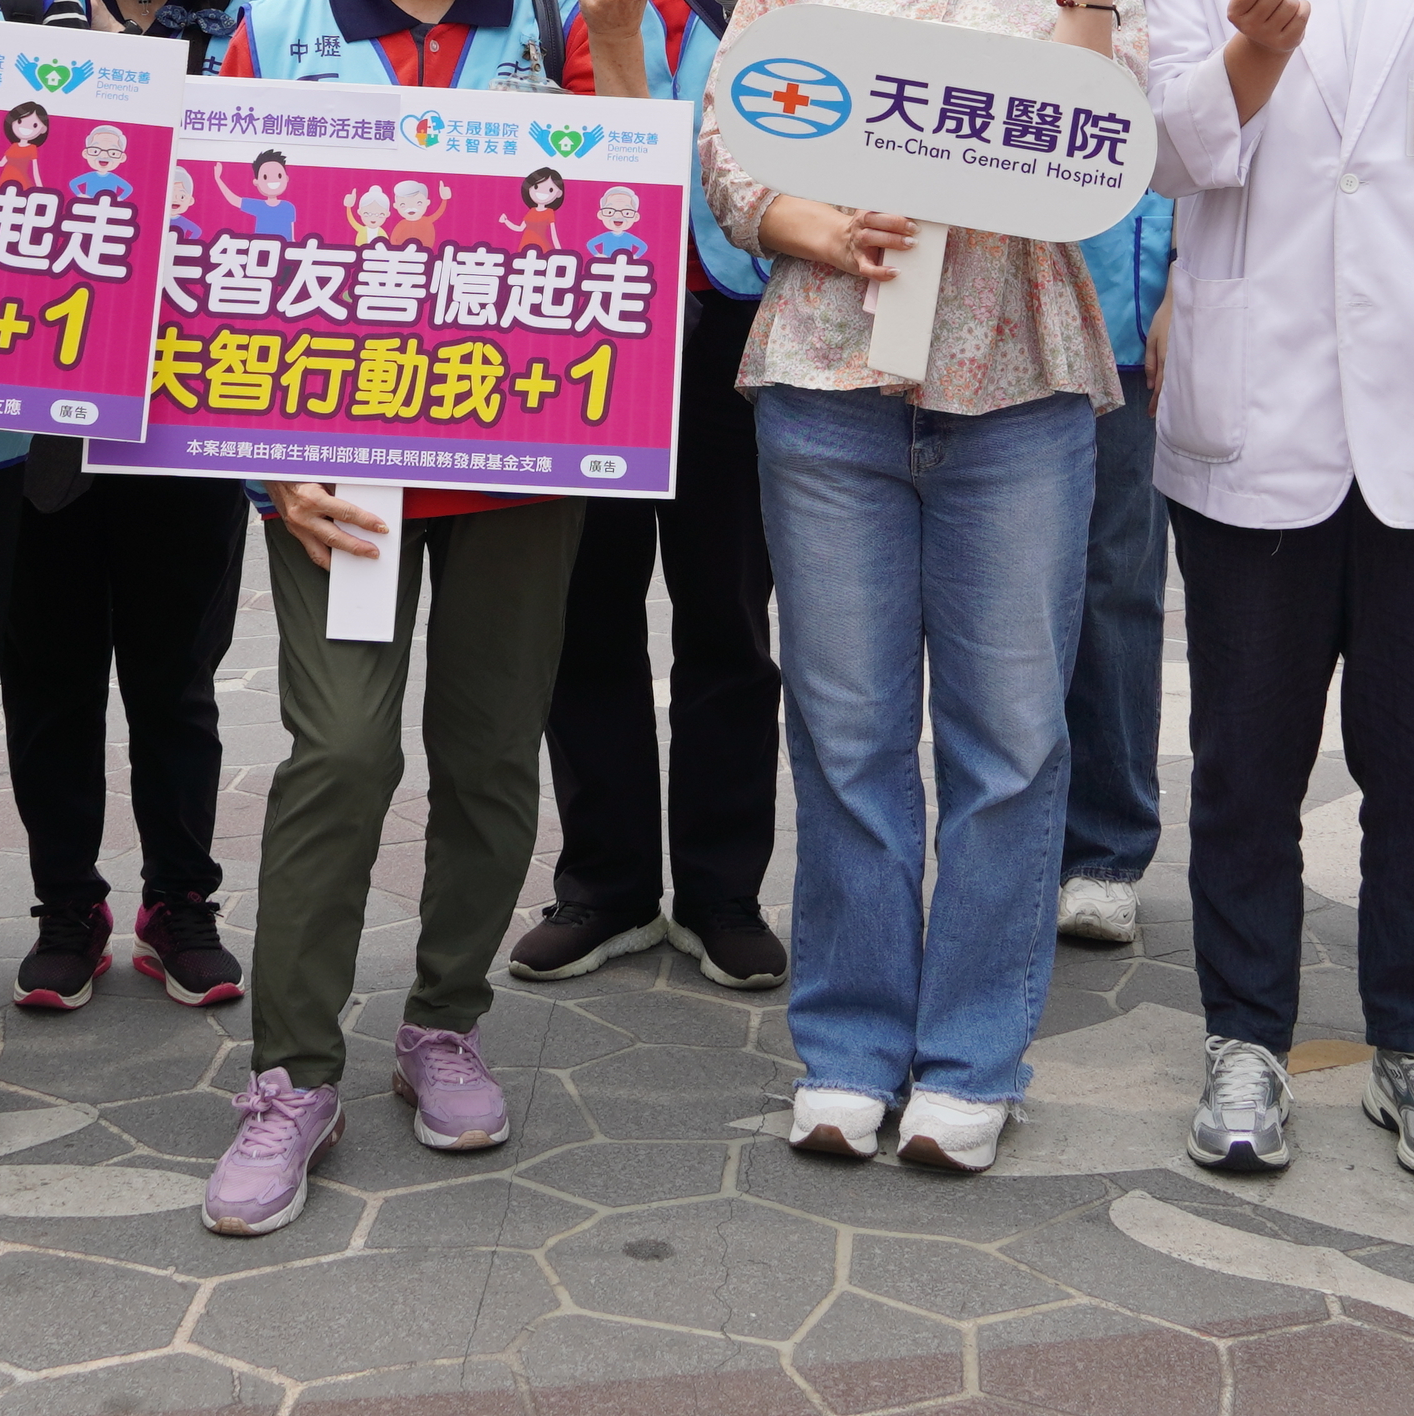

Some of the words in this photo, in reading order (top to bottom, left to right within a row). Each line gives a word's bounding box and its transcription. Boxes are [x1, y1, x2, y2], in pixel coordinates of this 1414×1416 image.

[289, 35, 342, 64] 中壢
[97, 67, 151, 85] 失智友善
[94, 89, 129, 102] Friends
[97, 80, 139, 93] Dementia
[179, 108, 229, 133] 陪伴
[262, 114, 396, 142] 創憶齡活走讀
[866, 73, 1131, 166] 天晟醫院
[446, 120, 520, 138] 天晟醫院
[607, 131, 659, 145] 失智友善
[445, 137, 519, 155] 失智友善
[607, 144, 649, 154] Dementia
[606, 153, 639, 163] Friends
[864, 130, 951, 160] Ten-Chan
[963, 147, 1036, 175] General
[1047, 161, 1123, 189] Hospital
[58, 404, 89, 420] 廣告
[186, 439, 553, 473] 本案經費由衛生福利部運用長照服務發展基金支應
[589, 460, 617, 474] 廣告
